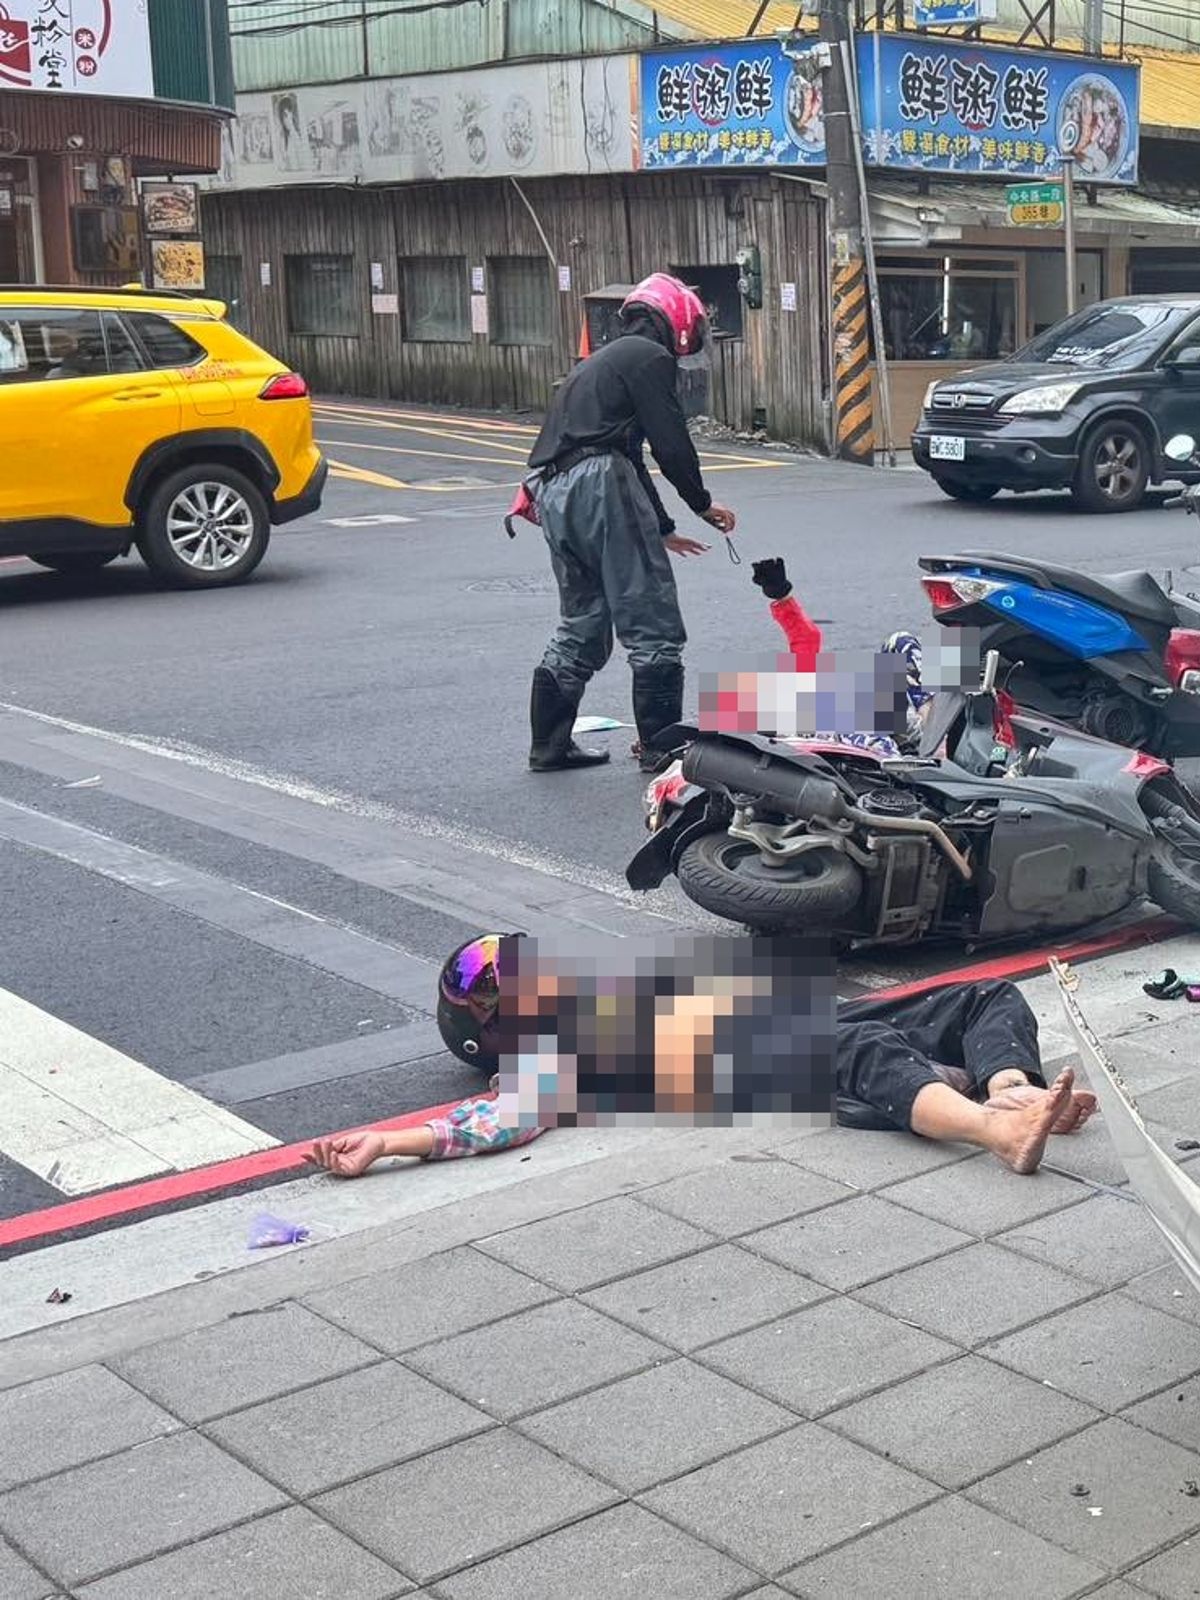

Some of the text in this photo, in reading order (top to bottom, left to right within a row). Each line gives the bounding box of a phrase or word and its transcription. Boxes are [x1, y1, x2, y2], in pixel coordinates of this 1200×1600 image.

[657, 57, 774, 124] 鮮粥鮮
[899, 52, 1049, 133] 鮮粥鮮
